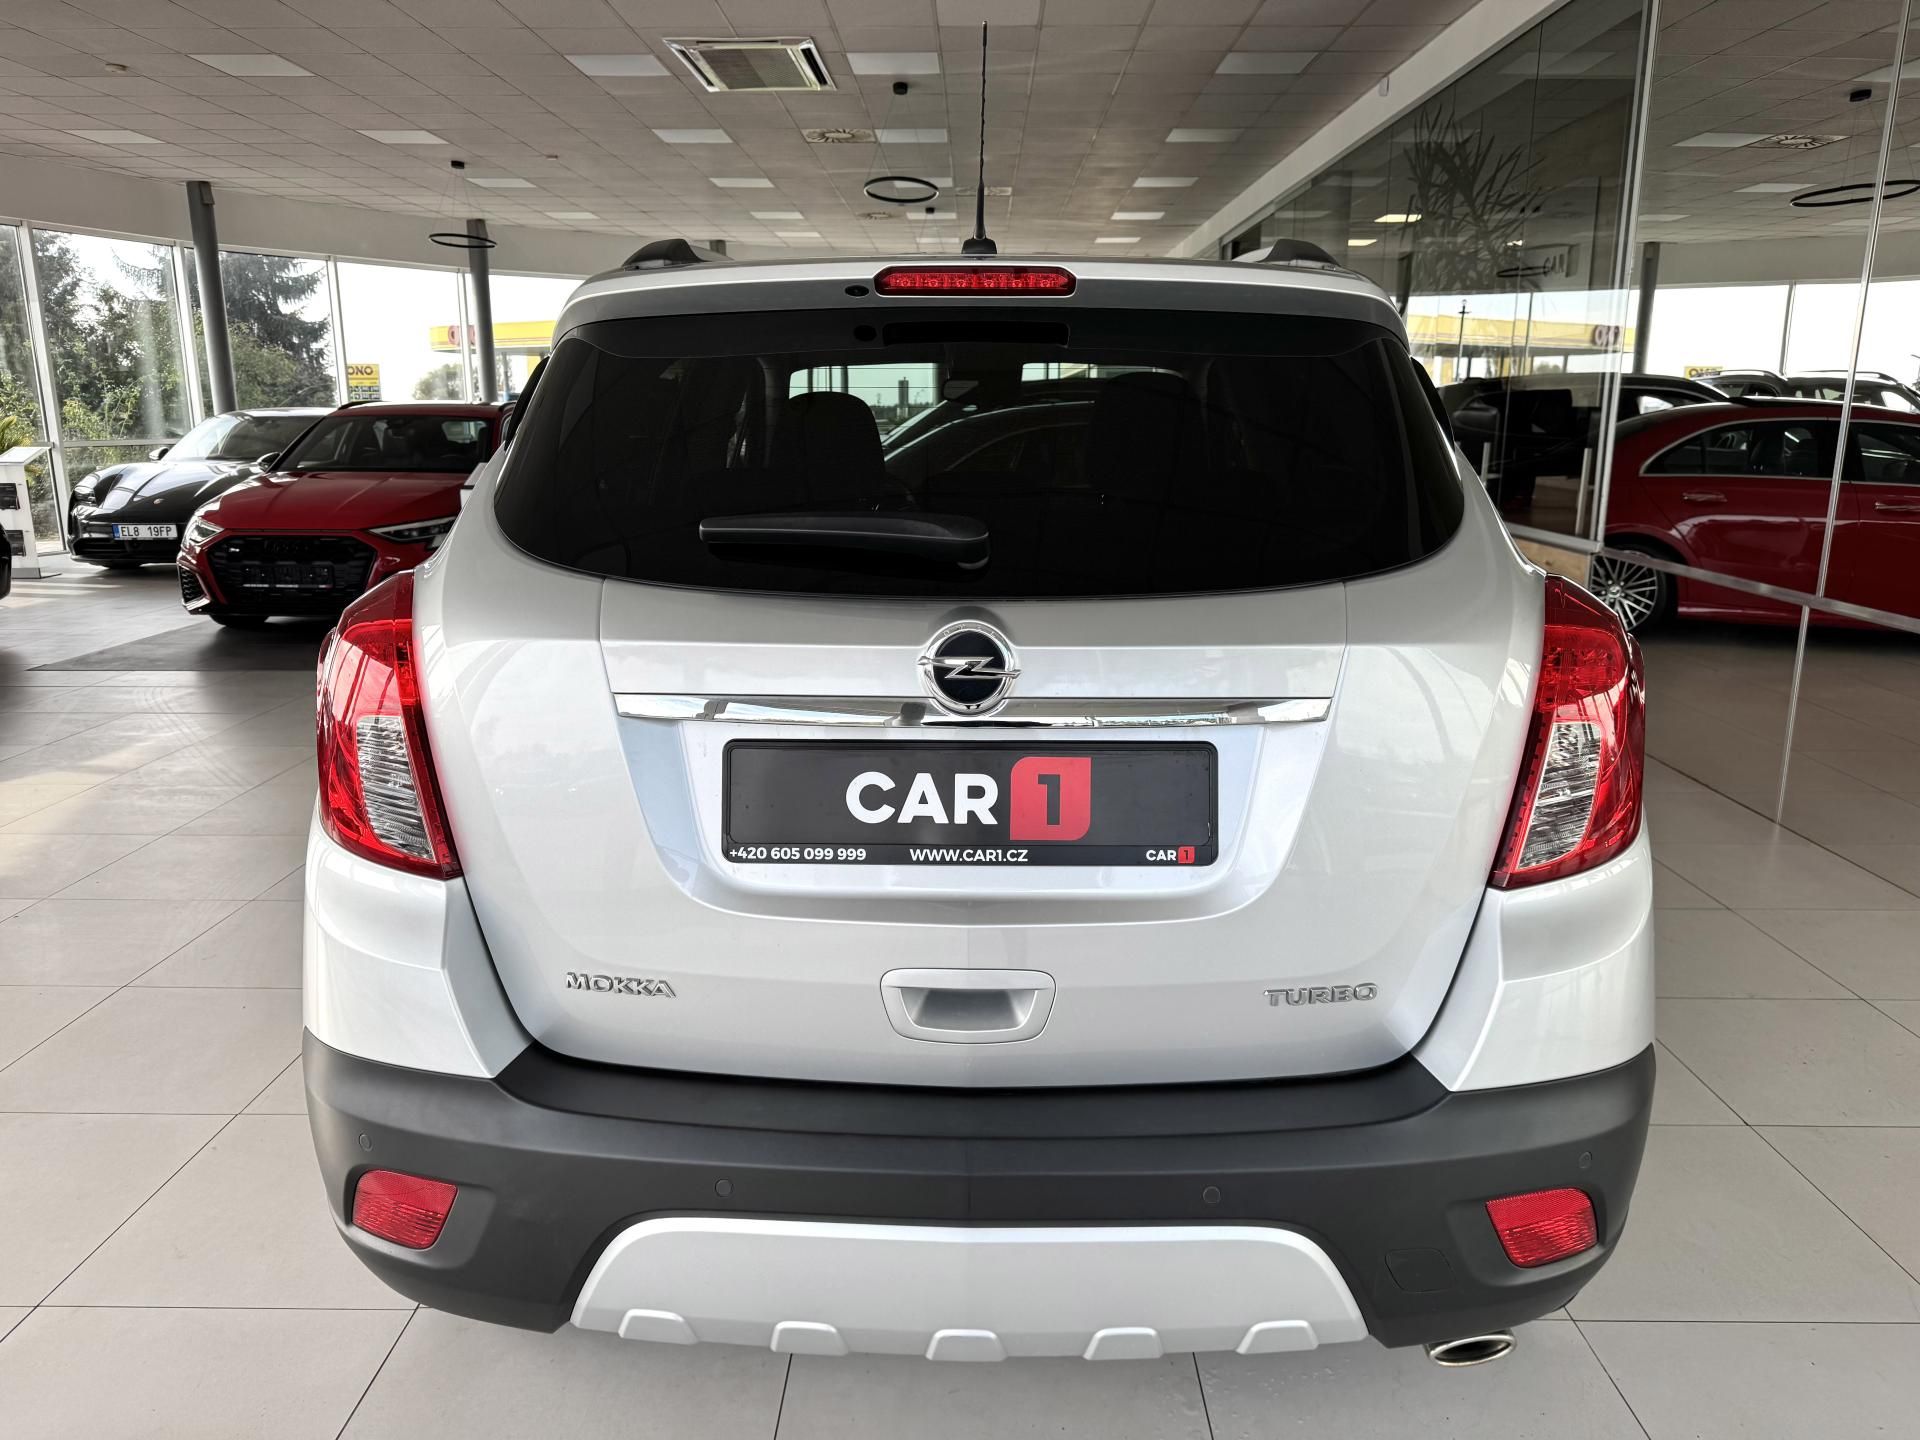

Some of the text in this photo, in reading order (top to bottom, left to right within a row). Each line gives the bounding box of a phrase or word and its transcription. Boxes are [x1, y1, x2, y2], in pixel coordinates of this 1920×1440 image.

[121, 526, 172, 537] EL8 19FP
[845, 771, 999, 825] CAR
[729, 847, 866, 860] +420 605 099 999
[909, 849, 1028, 862] WWW.CAR1.CZ
[1146, 850, 1176, 861] CAR
[565, 971, 677, 998] MOKKA
[1264, 983, 1378, 1007] TURBO
